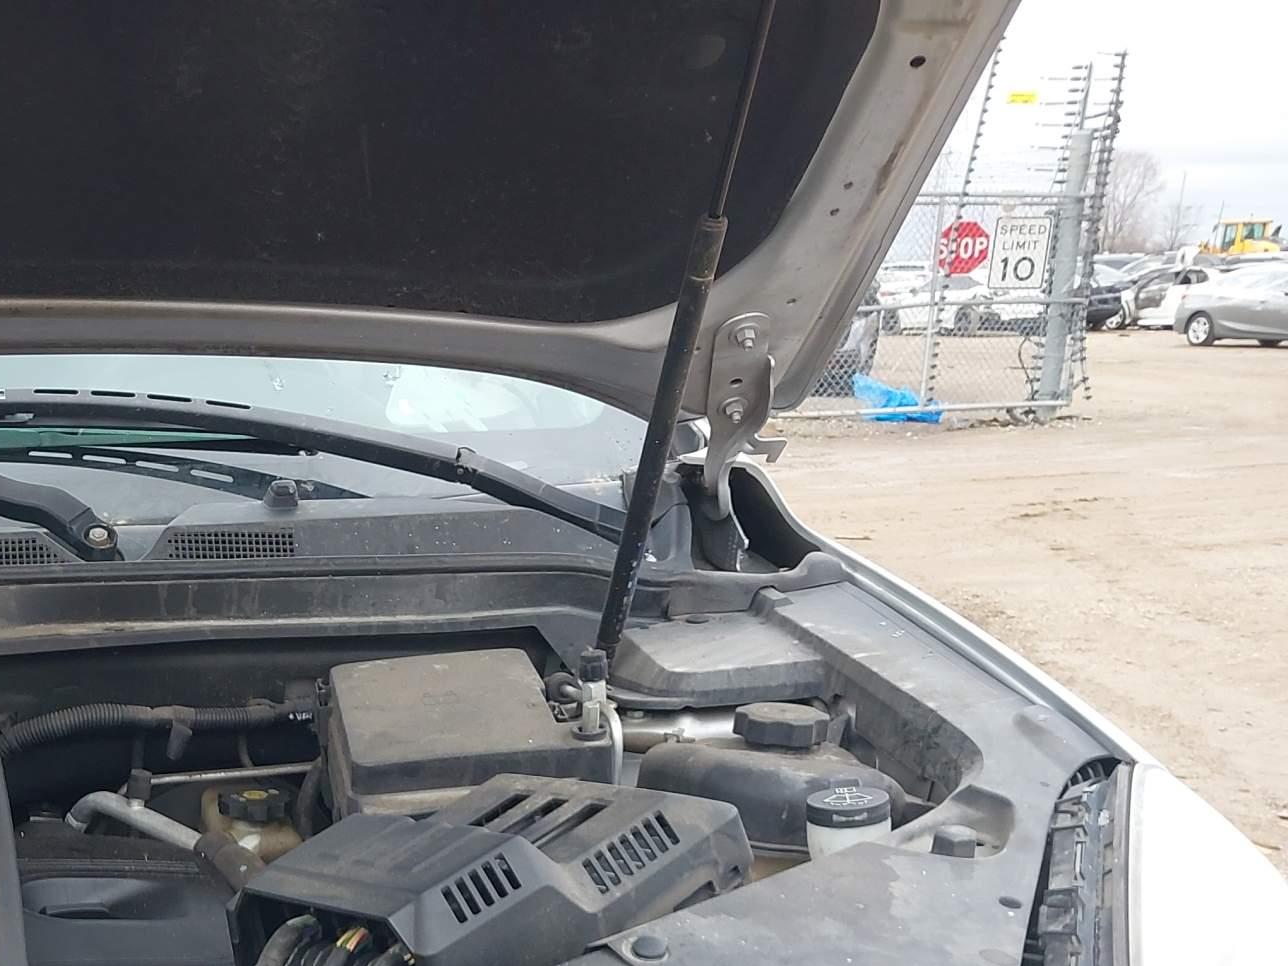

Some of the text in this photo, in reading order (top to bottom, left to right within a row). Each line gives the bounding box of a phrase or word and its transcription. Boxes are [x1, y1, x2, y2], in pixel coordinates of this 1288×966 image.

[999, 223, 1047, 236] SPEED
[1002, 239, 1040, 251] LIMIT
[1000, 256, 1035, 282] 10
